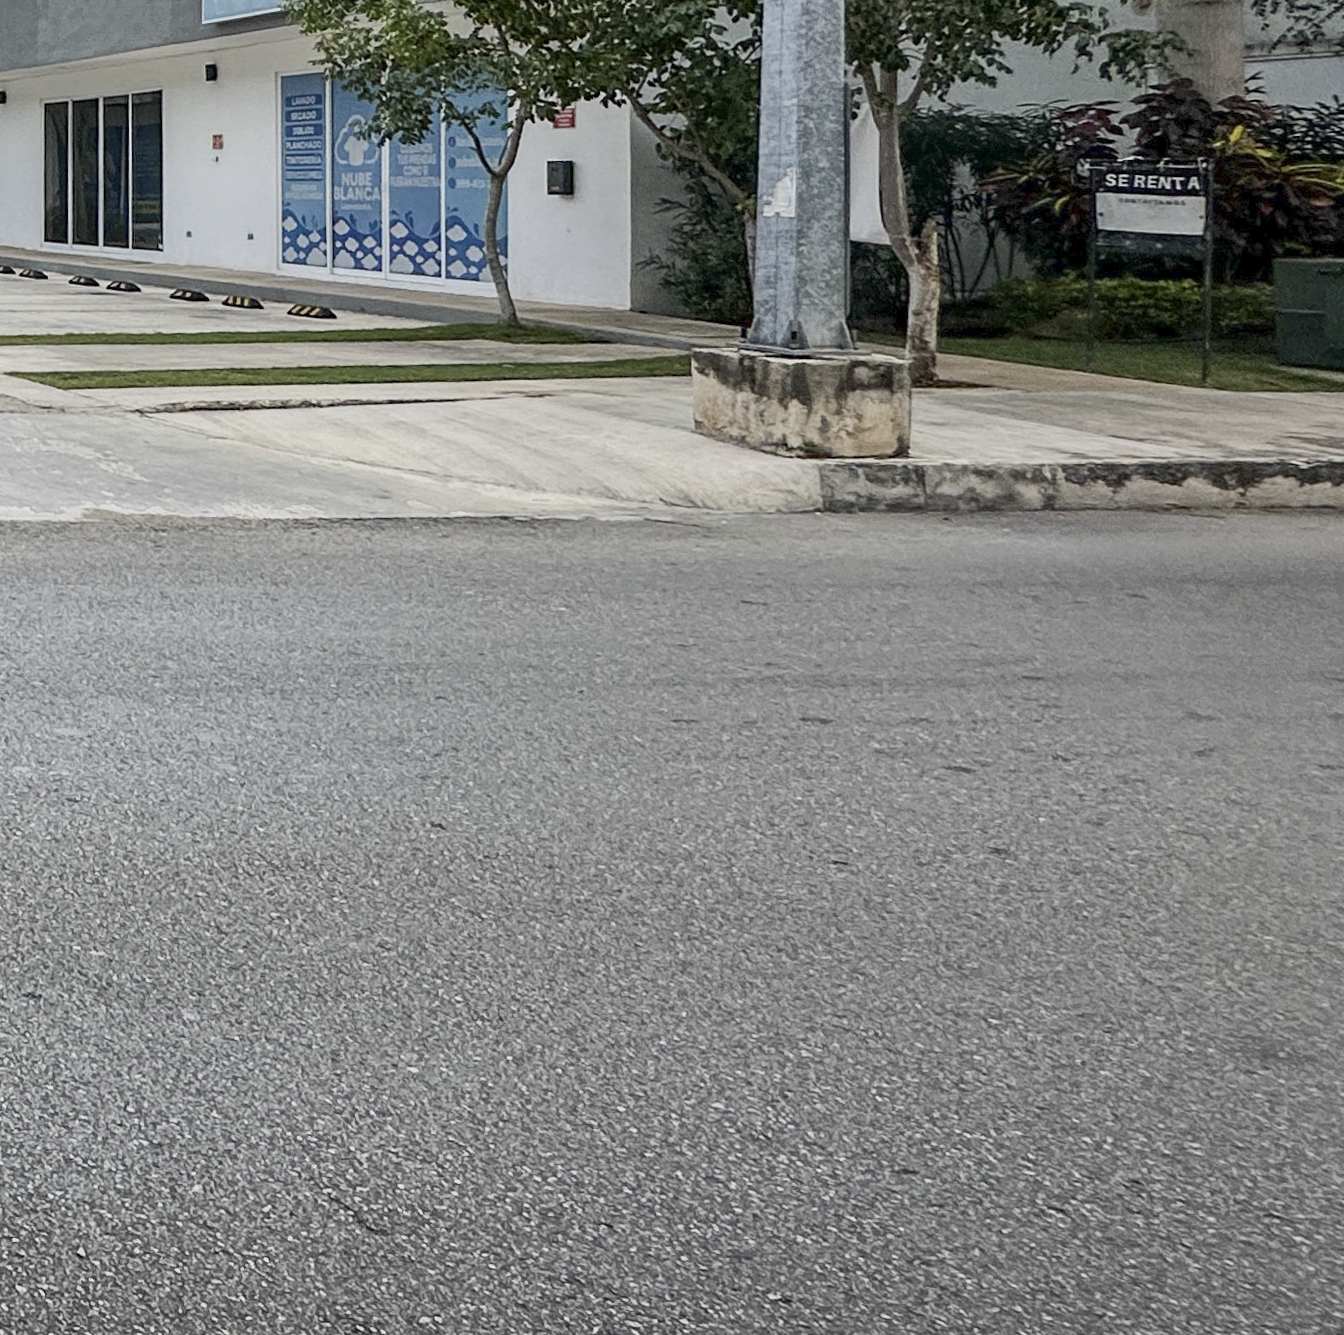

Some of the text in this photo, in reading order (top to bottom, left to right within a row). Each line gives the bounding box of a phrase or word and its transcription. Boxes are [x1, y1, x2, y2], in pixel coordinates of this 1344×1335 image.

[340, 172, 373, 187] NUBE
[1105, 173, 1201, 191] SE RENTA
[333, 185, 381, 201] BLANCA
